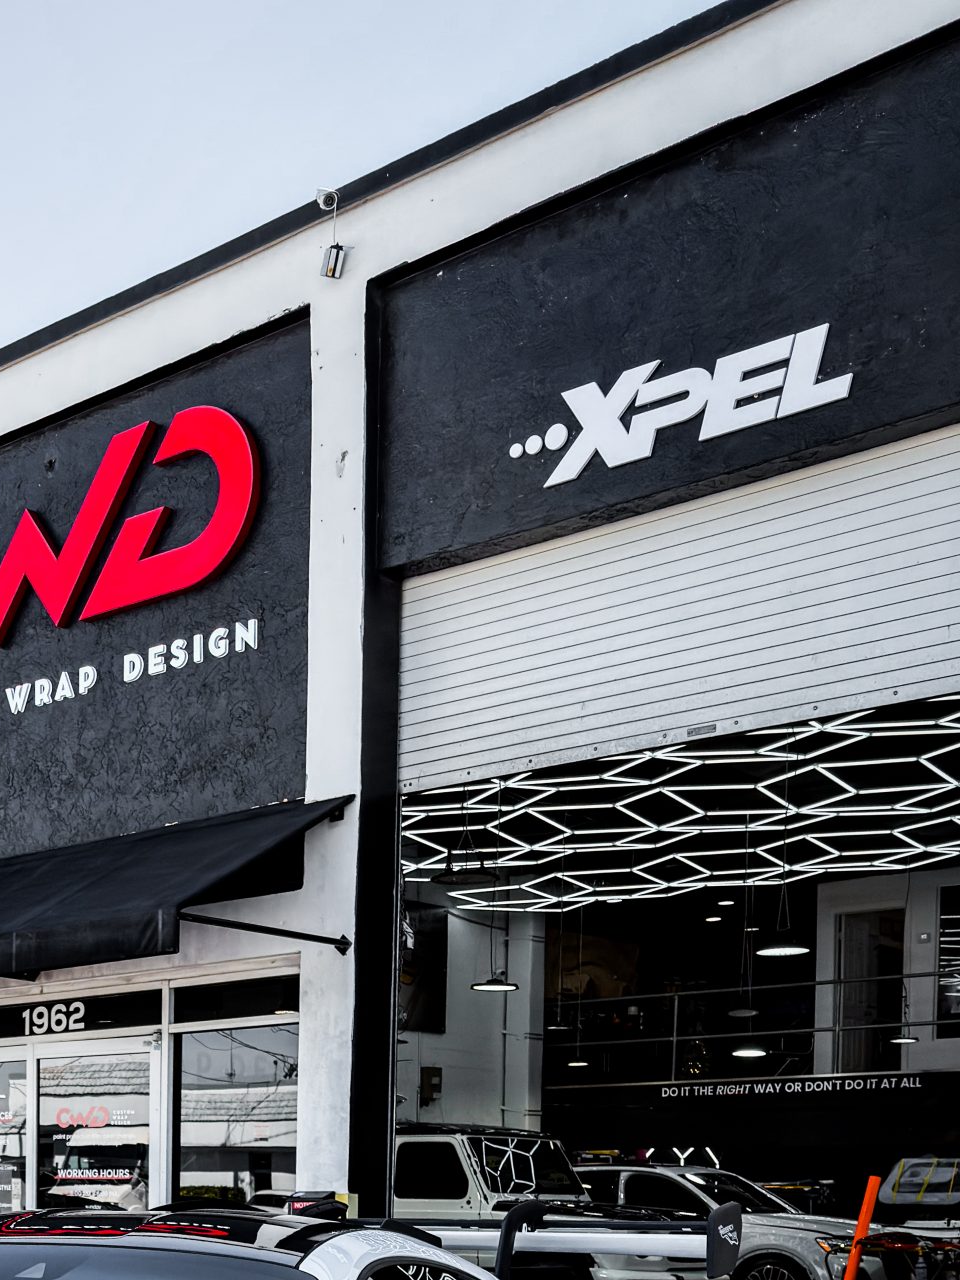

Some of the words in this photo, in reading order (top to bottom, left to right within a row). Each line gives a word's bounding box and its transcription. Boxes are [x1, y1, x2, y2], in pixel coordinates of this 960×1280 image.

[543, 323, 853, 488] XPEL
[5, 666, 98, 715] WRAP
[123, 619, 259, 684] DESIGN
[22, 1001, 86, 1036] 1962
[661, 1087, 679, 1098] DO
[681, 1086, 692, 1097] IT
[693, 1086, 714, 1096] THE
[716, 1084, 751, 1096] RIGHT
[754, 1083, 782, 1094] WAY
[784, 1082, 802, 1093] OR
[805, 1080, 842, 1092] DON'T
[845, 1079, 864, 1090] DO
[866, 1078, 878, 1089] IT
[880, 1078, 897, 1089] AT
[900, 1077, 922, 1088] ALL
[55, 1106, 110, 1128] CWD
[58, 1169, 98, 1178] WORKING
[100, 1169, 130, 1178] HOURS
